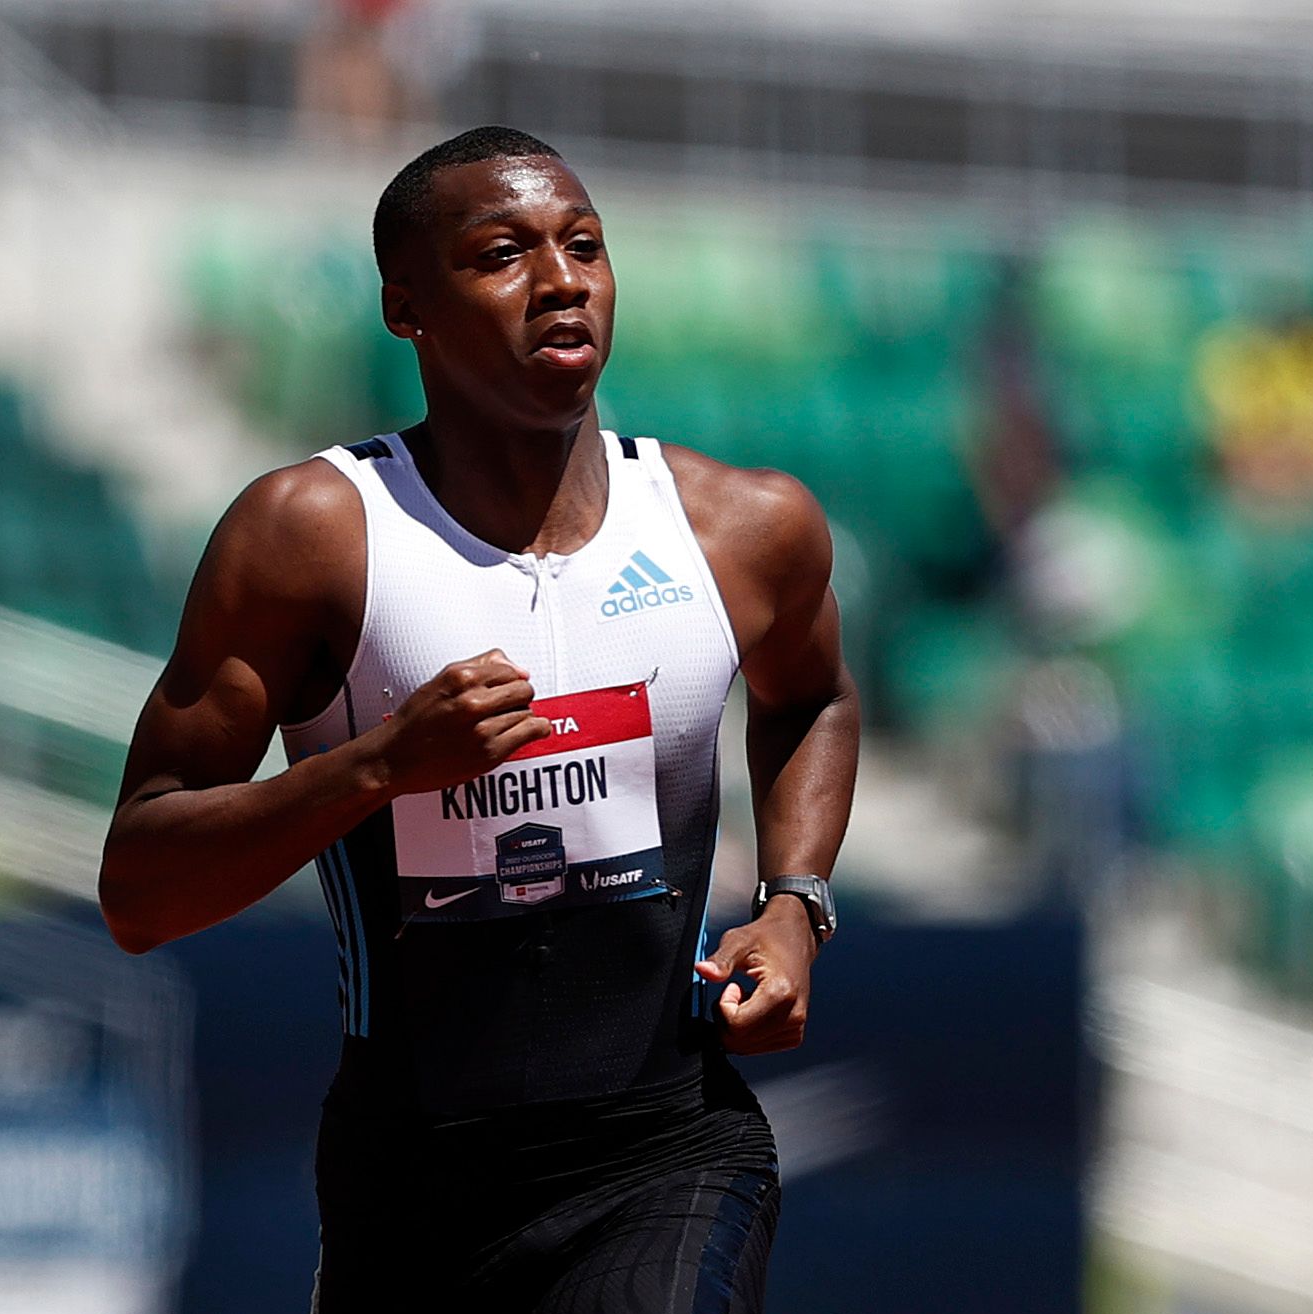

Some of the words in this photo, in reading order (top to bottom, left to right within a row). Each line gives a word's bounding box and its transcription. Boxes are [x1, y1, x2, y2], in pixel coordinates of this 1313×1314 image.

[601, 585, 694, 617] adidas
[441, 756, 608, 820] KNIGHTON
[600, 868, 644, 887] USATF
